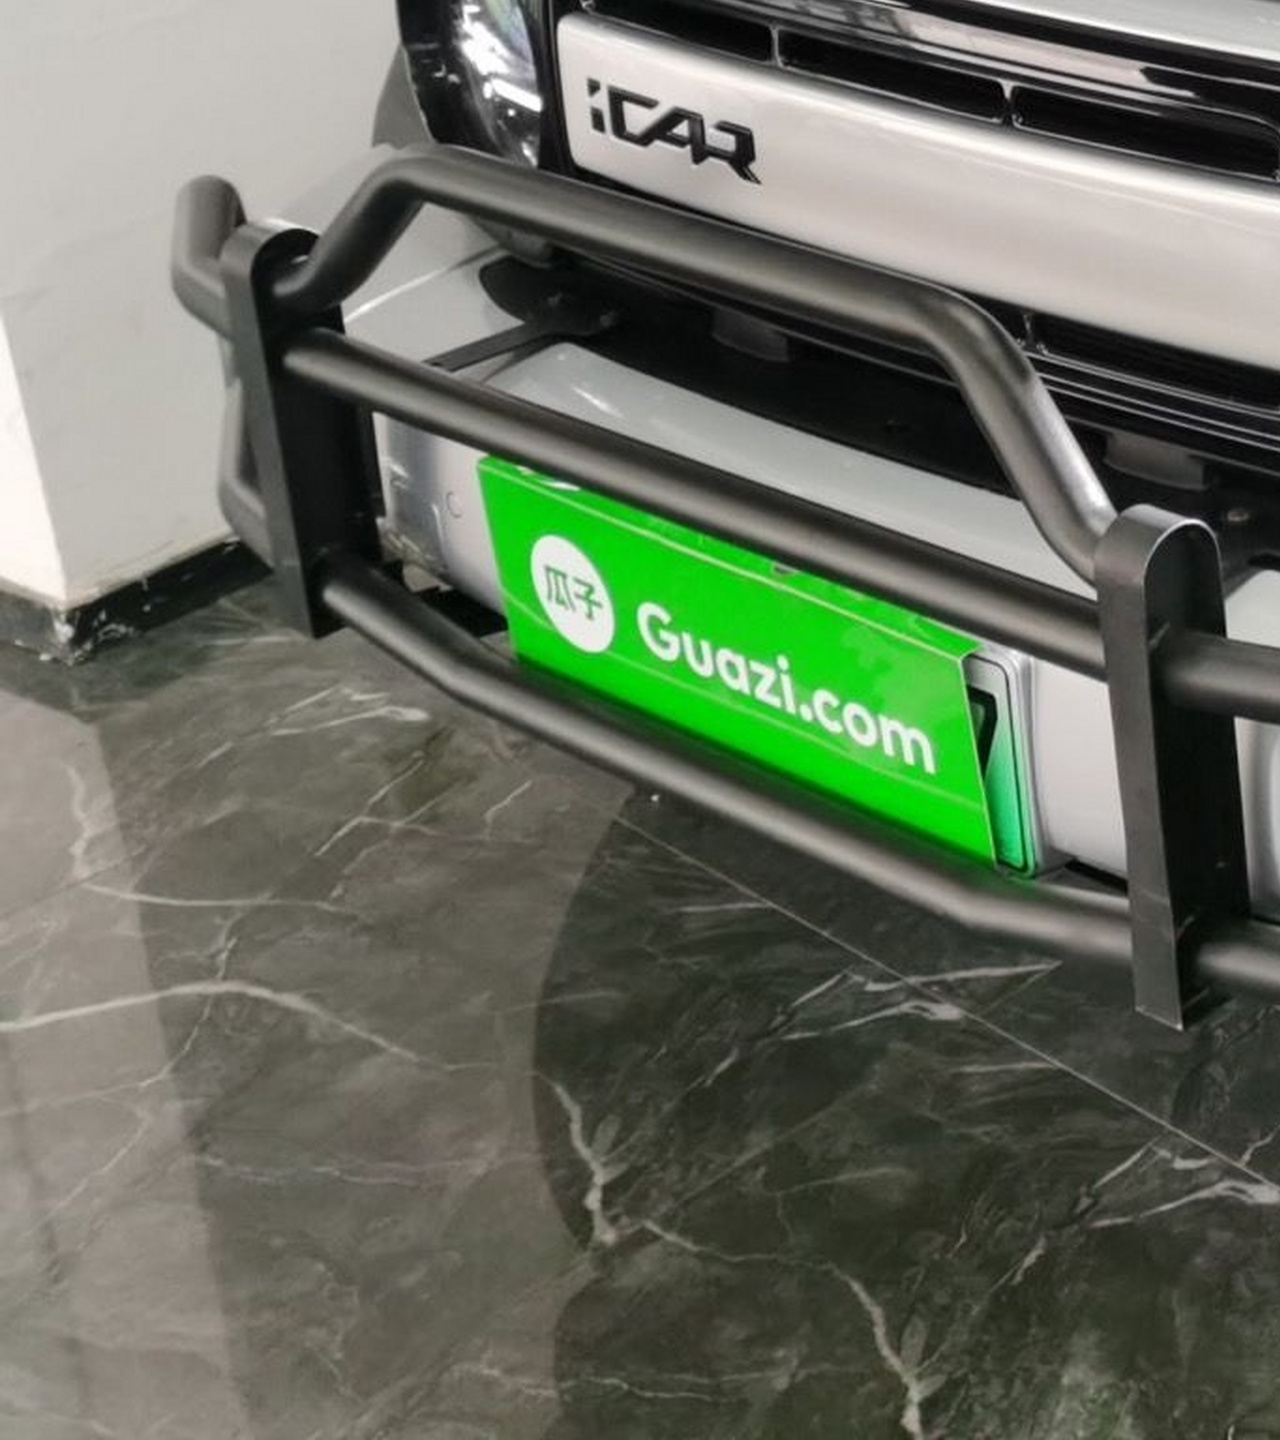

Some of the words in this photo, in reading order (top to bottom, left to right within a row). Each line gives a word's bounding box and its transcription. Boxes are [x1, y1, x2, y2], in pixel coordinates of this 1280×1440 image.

[587, 77, 762, 185] iCAR
[544, 564, 604, 621] 瓜子
[637, 601, 937, 775] Guazi.com
